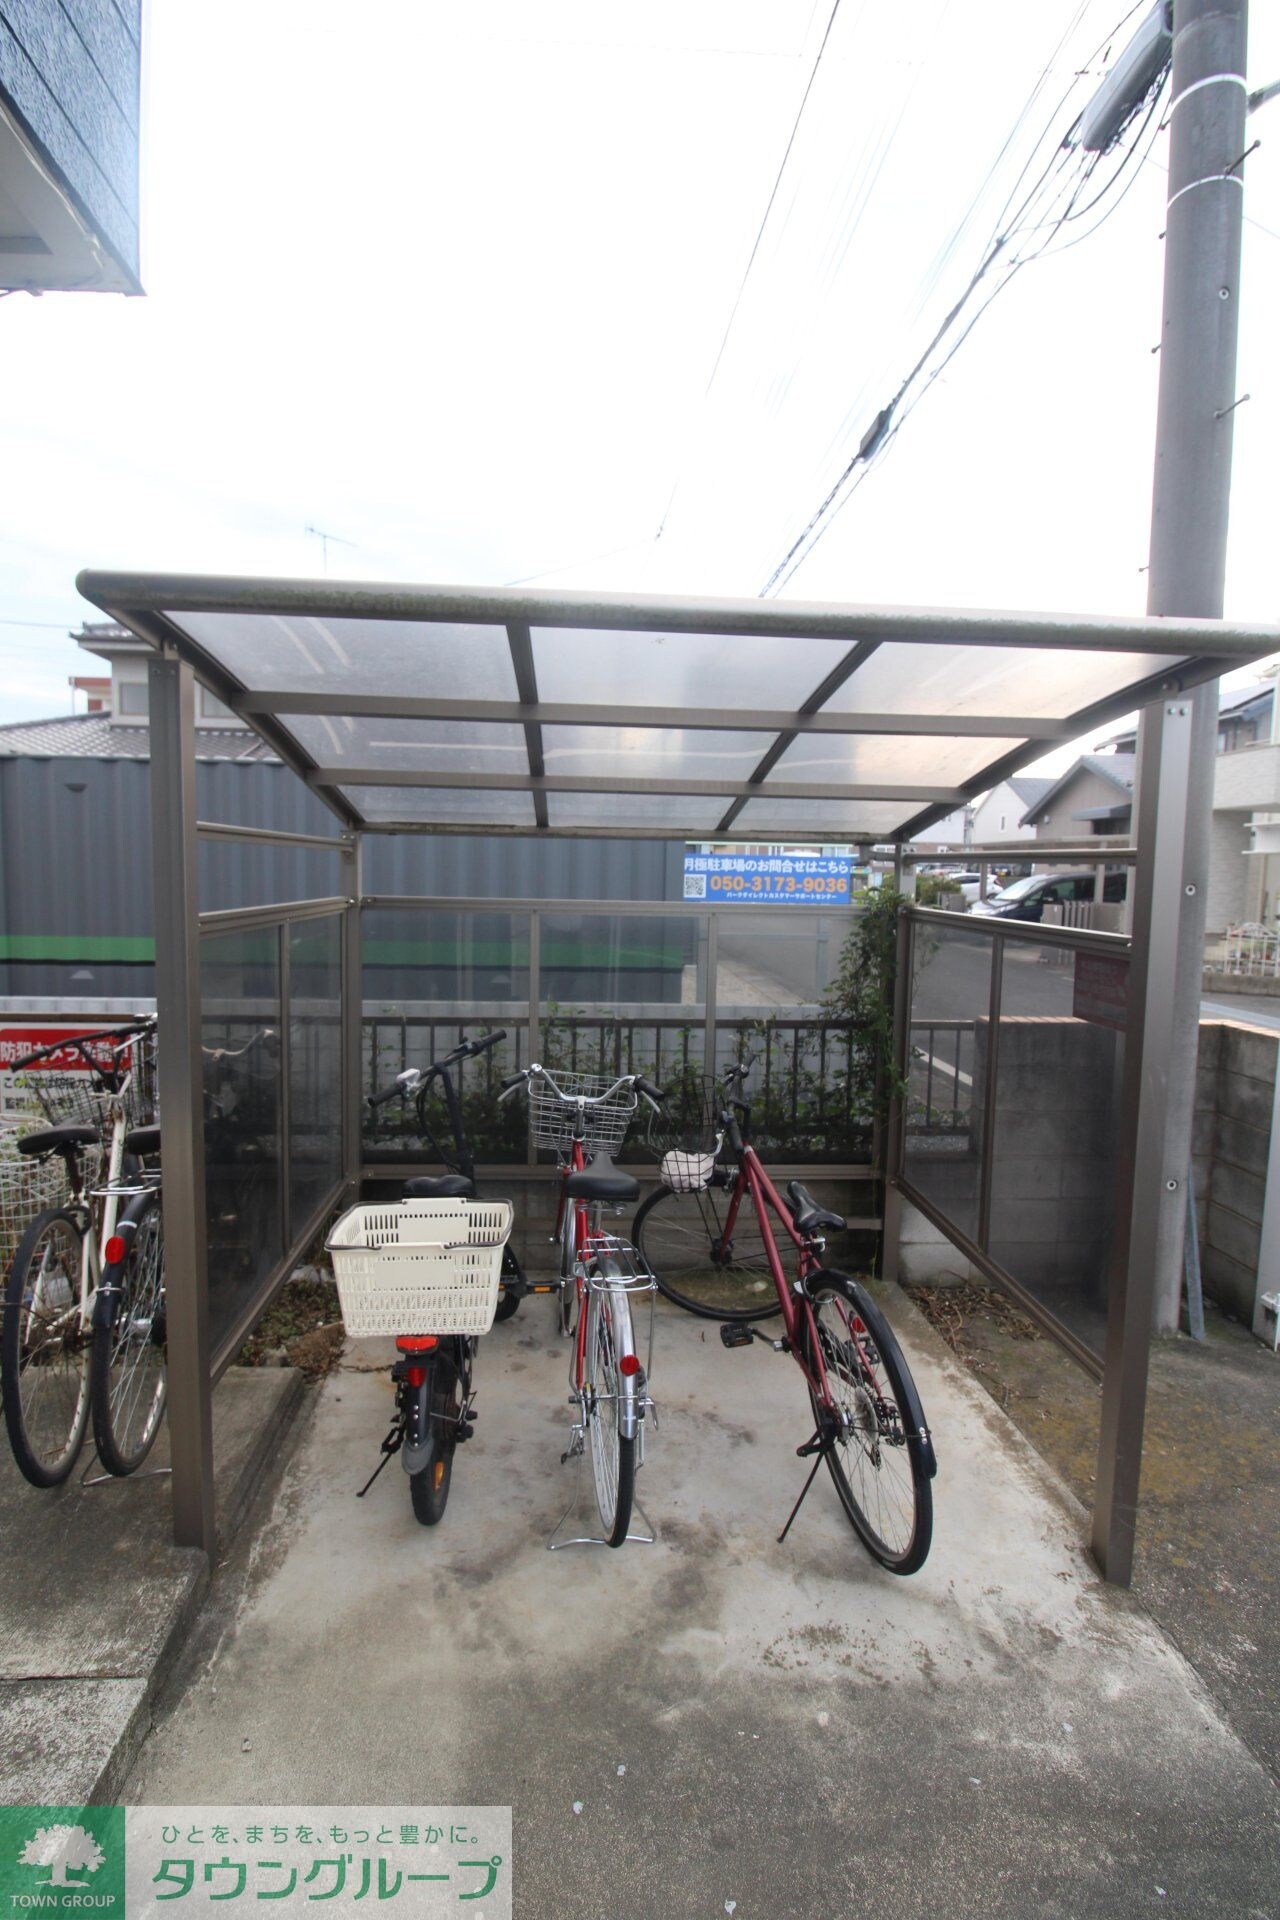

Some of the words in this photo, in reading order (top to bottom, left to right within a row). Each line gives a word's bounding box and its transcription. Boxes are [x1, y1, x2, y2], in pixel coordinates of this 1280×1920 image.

[684, 857, 848, 873] 月極駐車場のお問合せはこちら
[710, 875, 848, 892] 050-3173-9036
